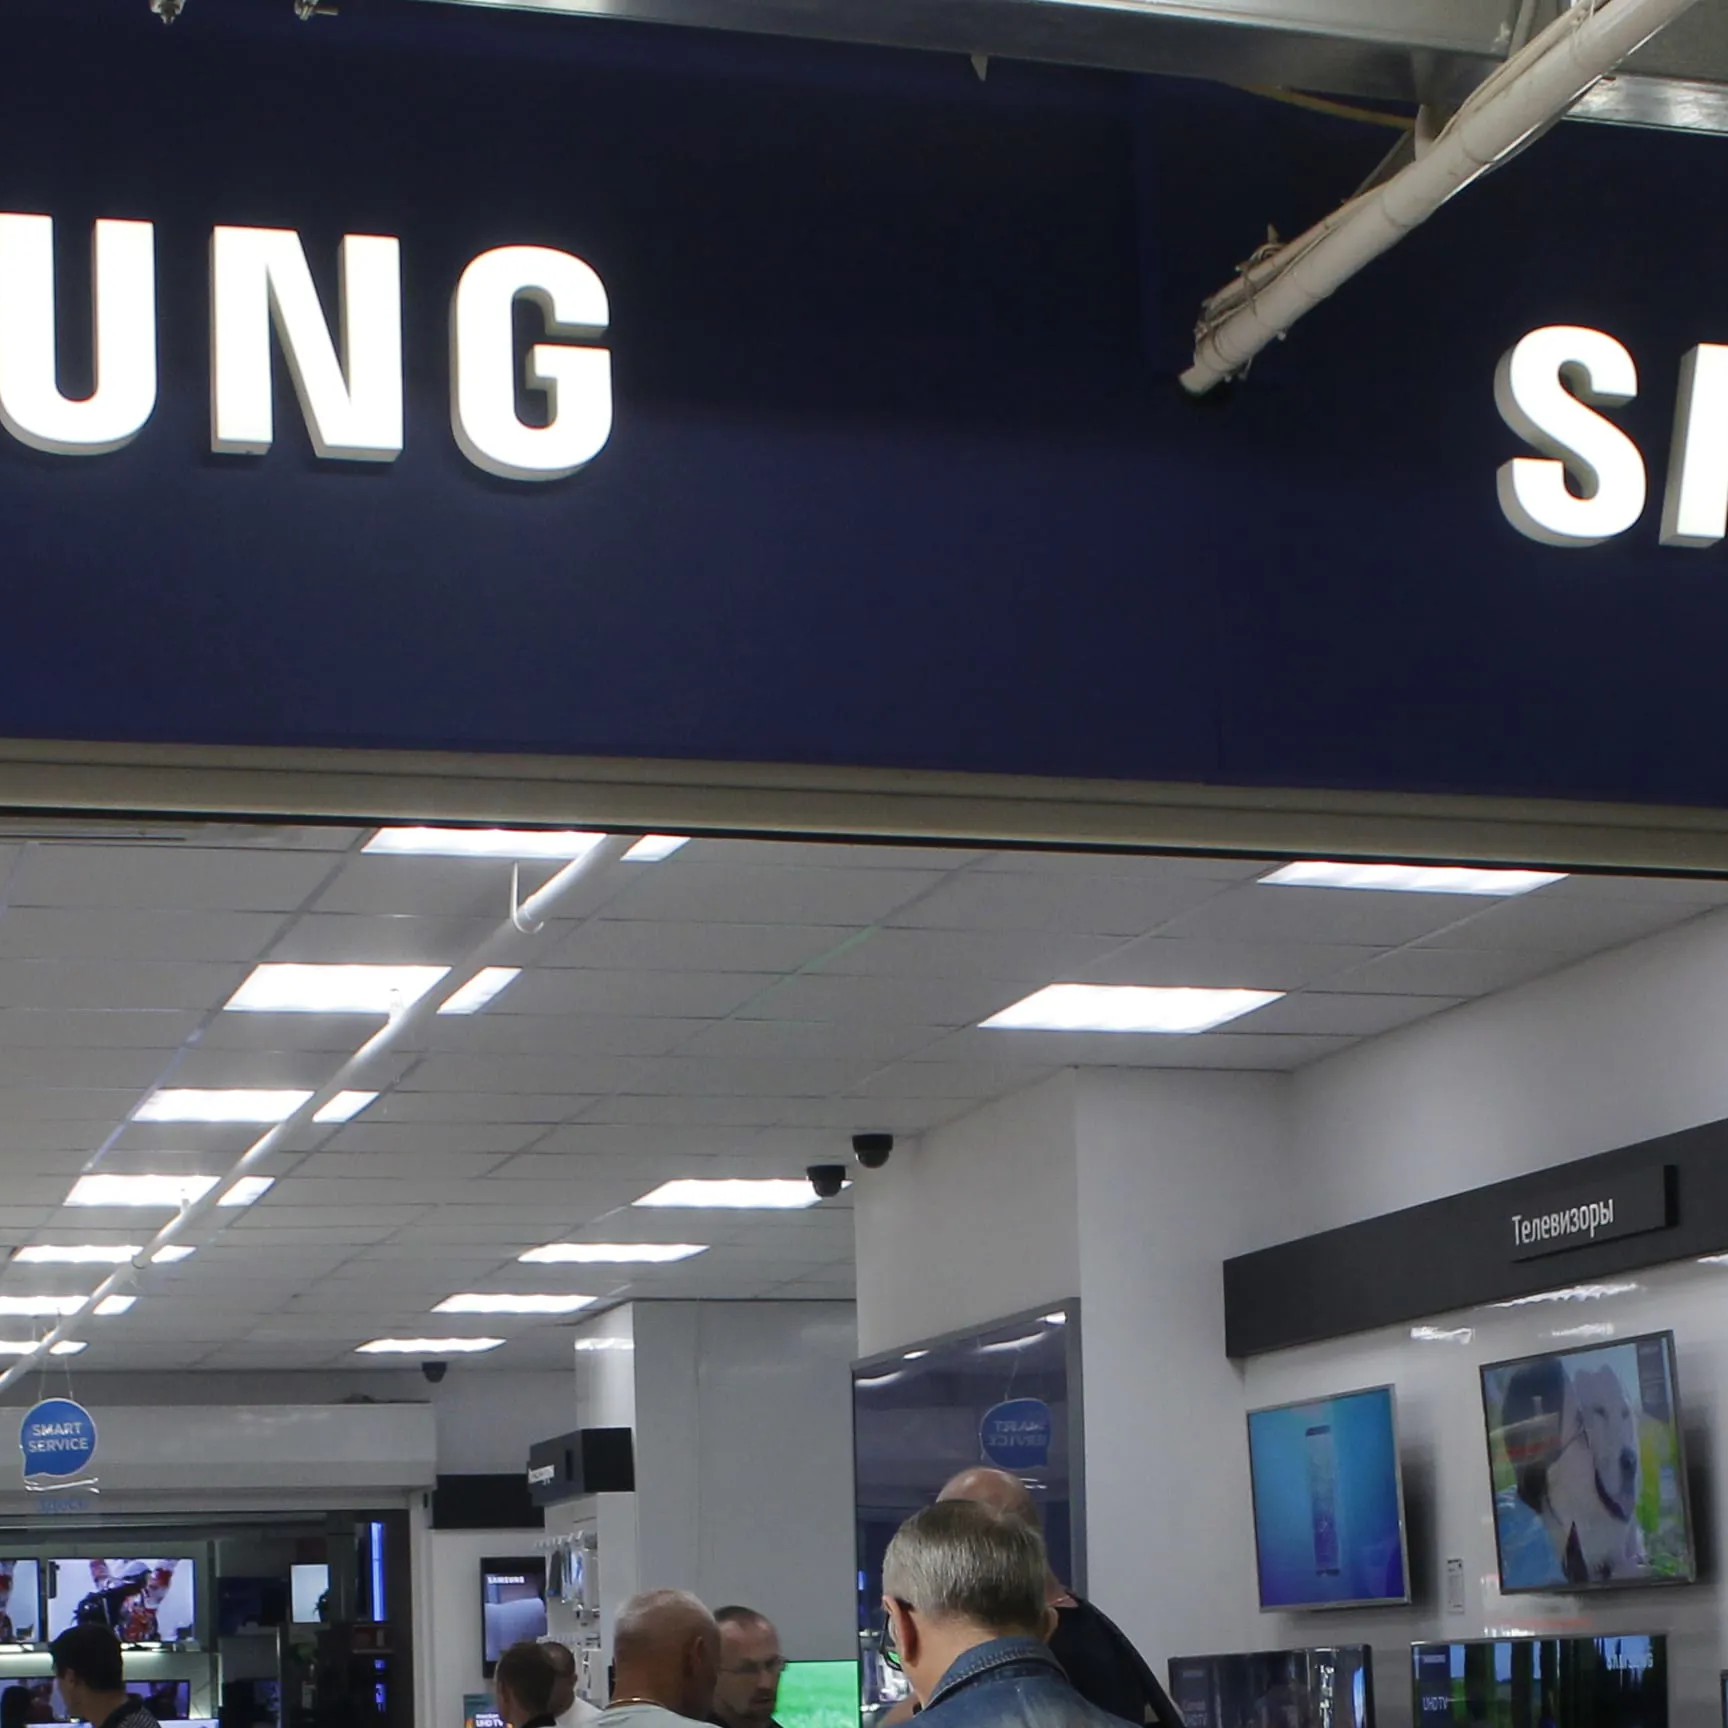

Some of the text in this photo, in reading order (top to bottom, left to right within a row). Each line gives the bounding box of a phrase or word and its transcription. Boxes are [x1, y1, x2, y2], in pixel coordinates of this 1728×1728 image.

[1512, 1199, 1614, 1246] Телевизоры
[32, 1422, 82, 1436] SMART
[28, 1437, 89, 1452] SERVICE
